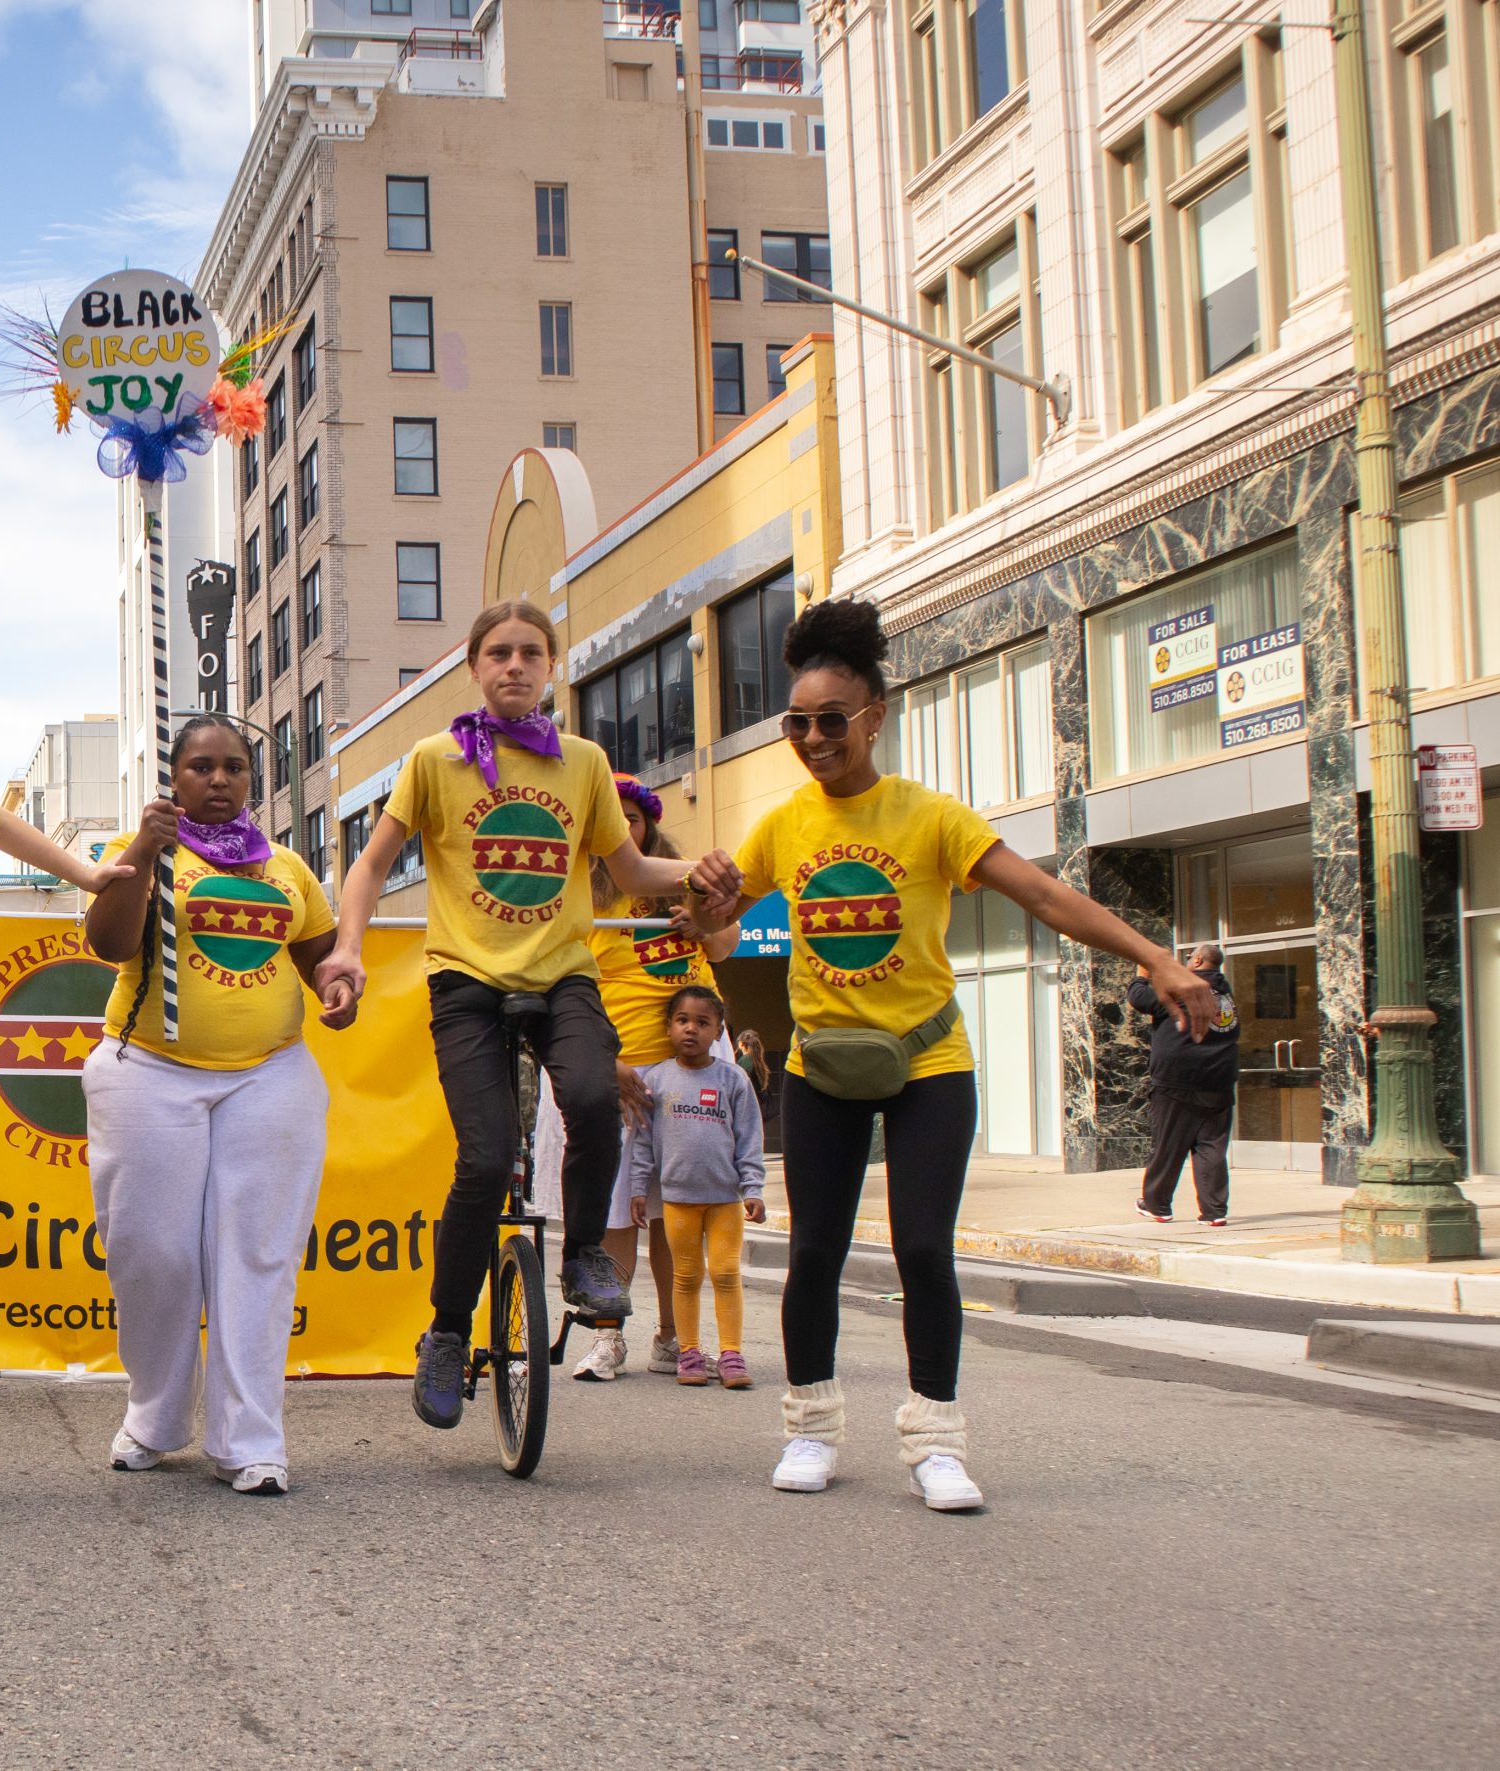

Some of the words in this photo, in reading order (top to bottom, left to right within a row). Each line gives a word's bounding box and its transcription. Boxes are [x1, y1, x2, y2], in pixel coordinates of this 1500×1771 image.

[82, 289, 202, 328] BLACK
[62, 330, 211, 369] CIRCUS
[86, 372, 184, 415] JOY
[1155, 622, 1177, 641] FOR
[1180, 610, 1208, 632] SALE
[1175, 634, 1209, 659] CCIG
[1223, 643, 1248, 664] FOR
[1252, 628, 1296, 655] LEASE
[1252, 658, 1294, 686] CCIG
[1154, 680, 1215, 709] 510.268.8500
[1225, 713, 1301, 746] 510.268.8500
[1420, 750, 1436, 767] NO
[1436, 751, 1476, 763] PARKING
[463, 785, 575, 831] PRESCOTT
[792, 843, 908, 895] PRESCOTT
[471, 891, 564, 925] CIRCUS
[758, 944, 781, 954] 564
[188, 953, 277, 989] CIRCUS
[806, 953, 905, 989] CIRCUS
[673, 1103, 727, 1119] LEGOLAND
